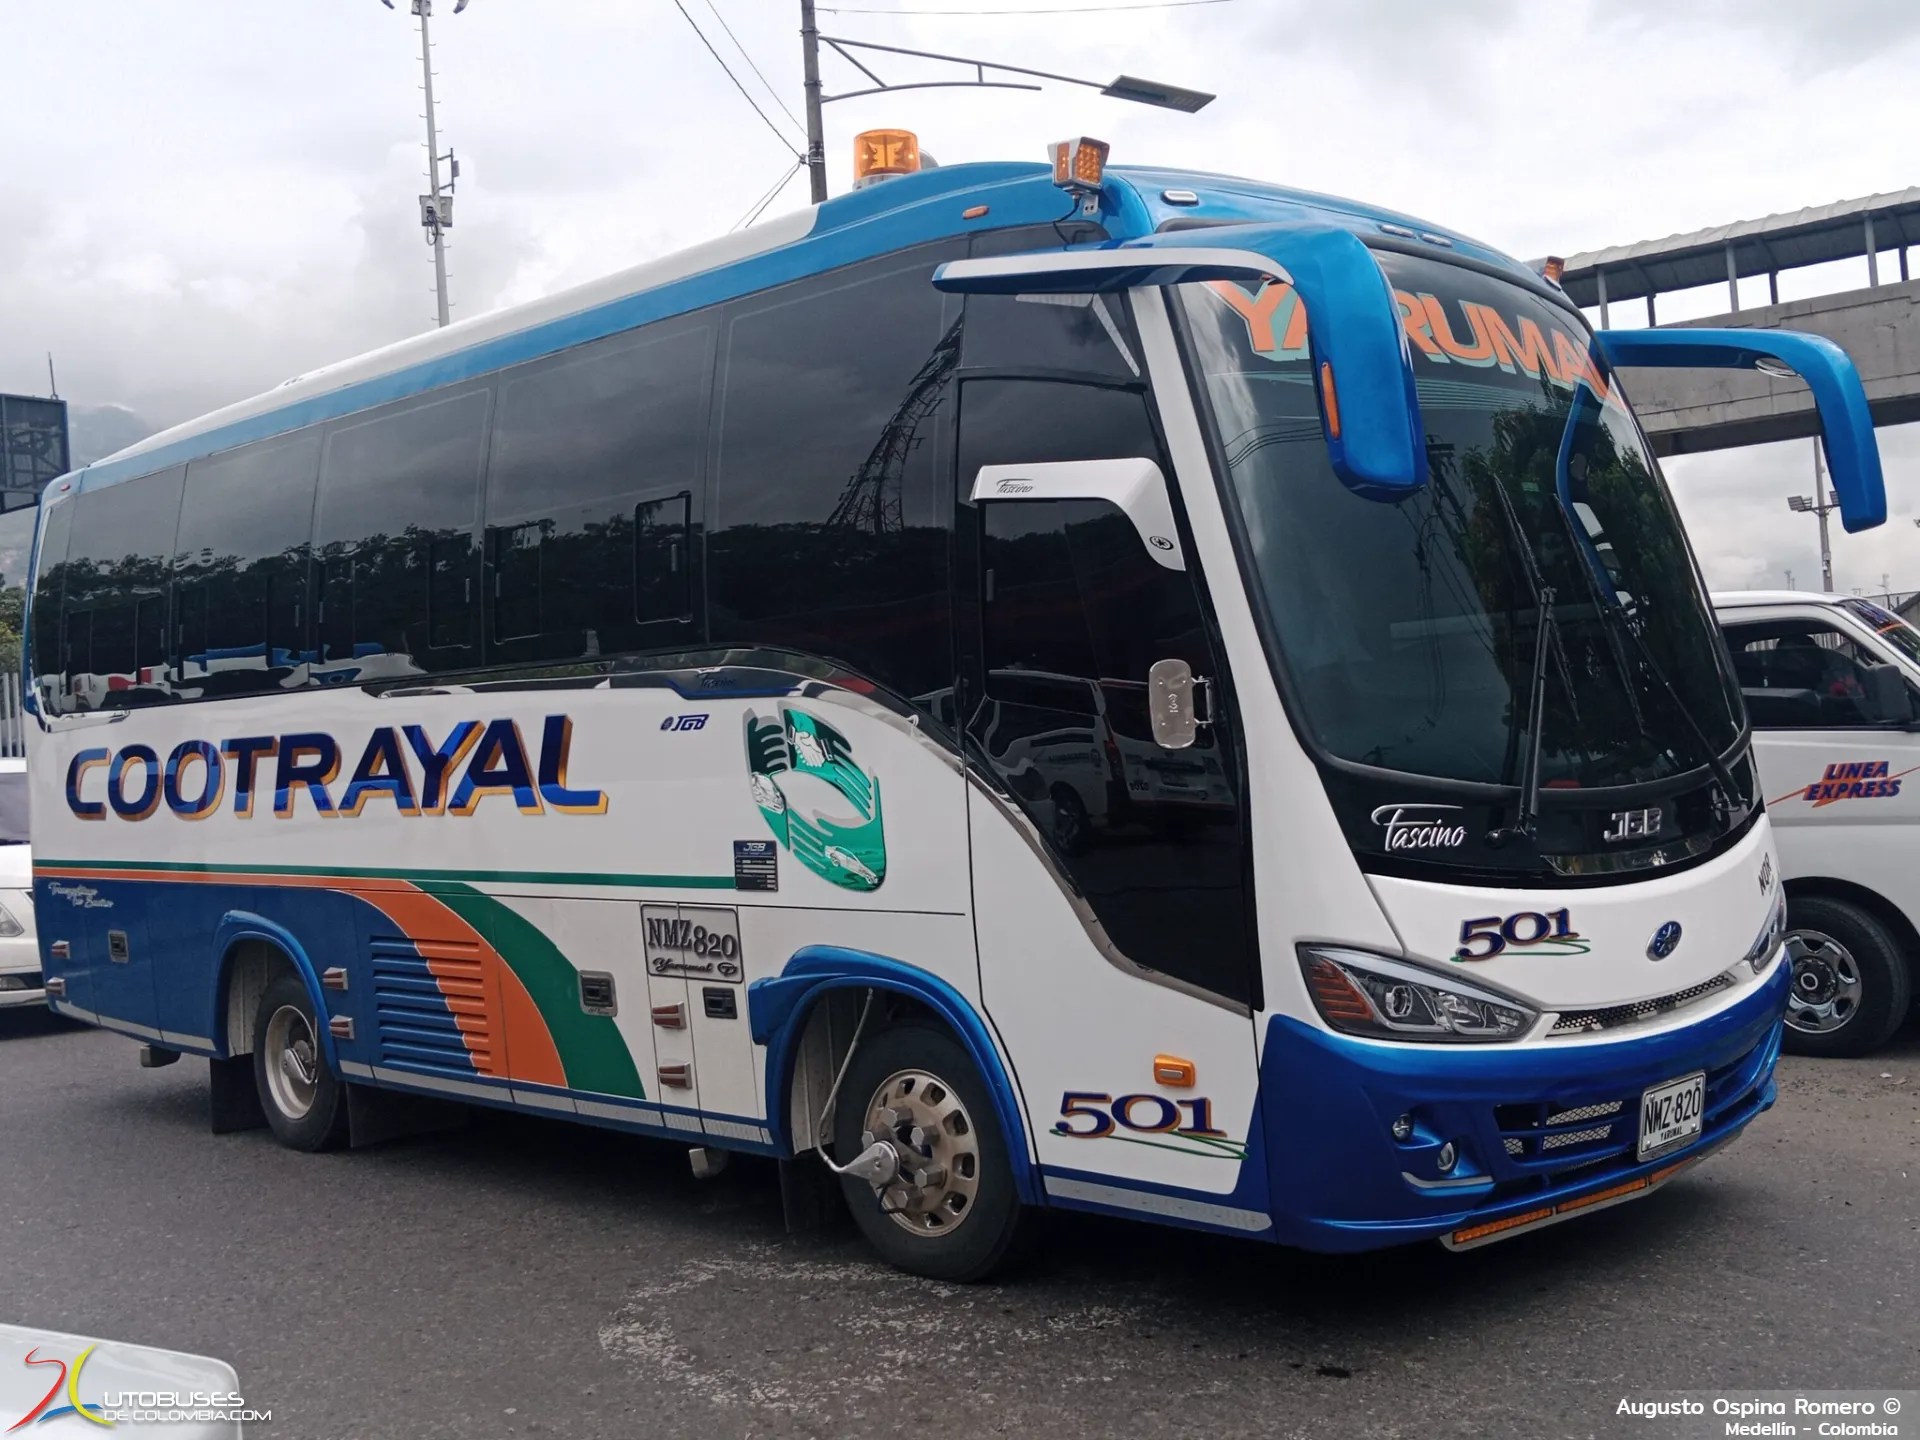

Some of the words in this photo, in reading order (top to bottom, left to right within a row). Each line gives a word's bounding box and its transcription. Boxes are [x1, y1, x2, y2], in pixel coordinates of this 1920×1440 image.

[671, 713, 710, 731] JGB
[65, 714, 608, 822] COOTRAYAL
[1822, 761, 1889, 780] LINEA
[1802, 779, 1902, 801] EXPRESS
[1371, 803, 1467, 852] Fascino
[1604, 807, 1662, 840] JGB
[646, 917, 738, 960] NMZ820
[1456, 906, 1580, 962] 501
[1055, 1091, 1228, 1139] 501
